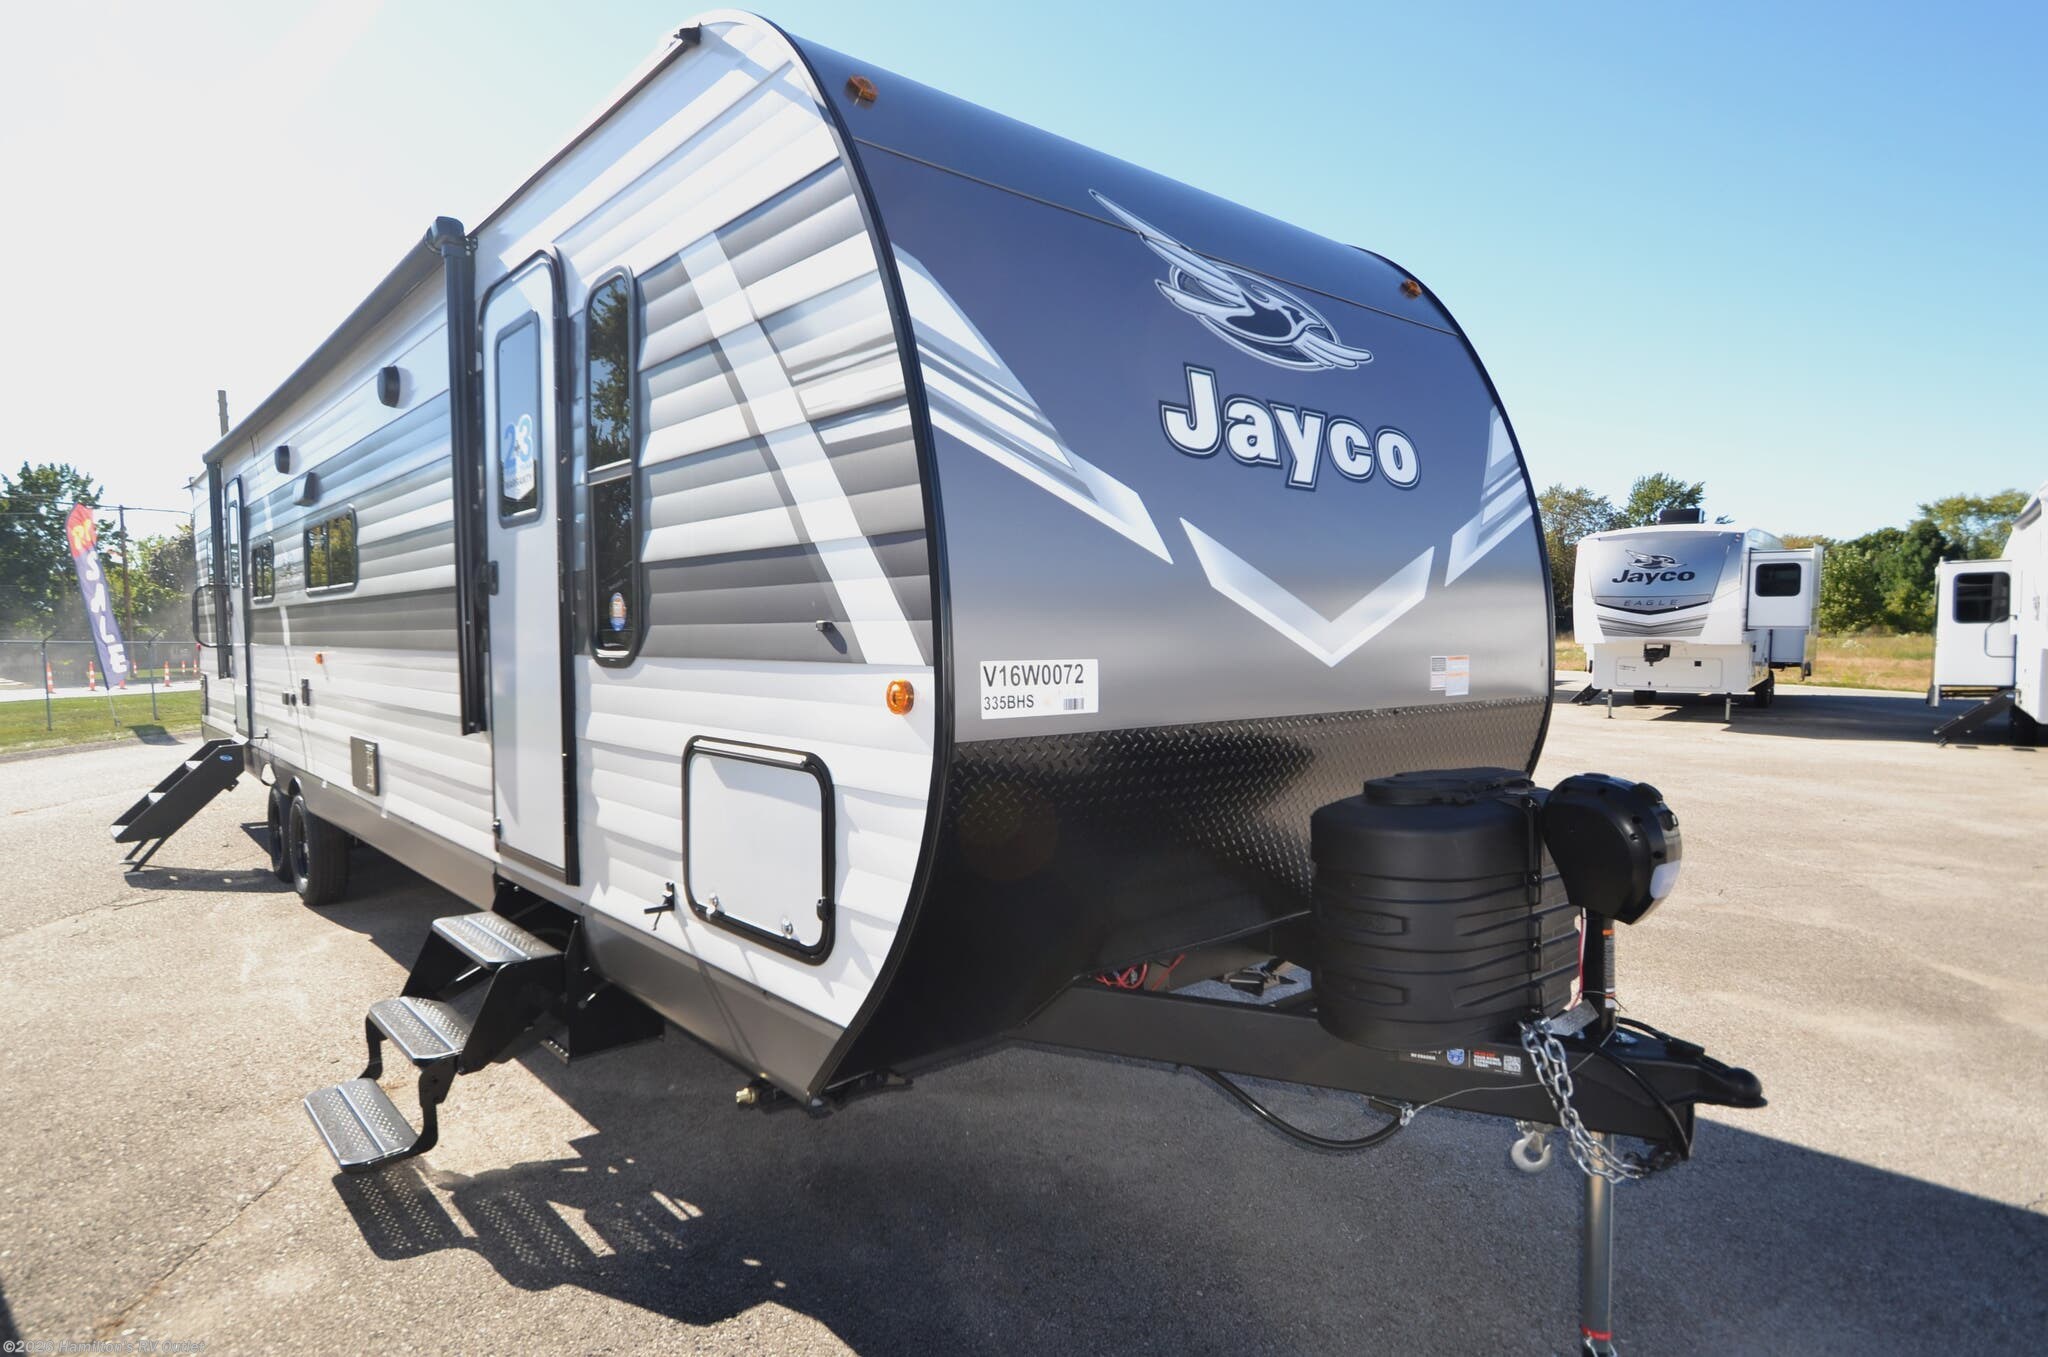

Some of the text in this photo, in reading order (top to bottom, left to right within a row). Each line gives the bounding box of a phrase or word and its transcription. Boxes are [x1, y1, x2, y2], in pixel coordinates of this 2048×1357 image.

[1159, 362, 1422, 492] Jayco
[1612, 569, 1696, 585] Jayco
[85, 550, 128, 674] SALE
[1623, 599, 1680, 607] EAGLE
[983, 663, 1085, 688] V16W0072
[983, 694, 1035, 711] 335BHS
